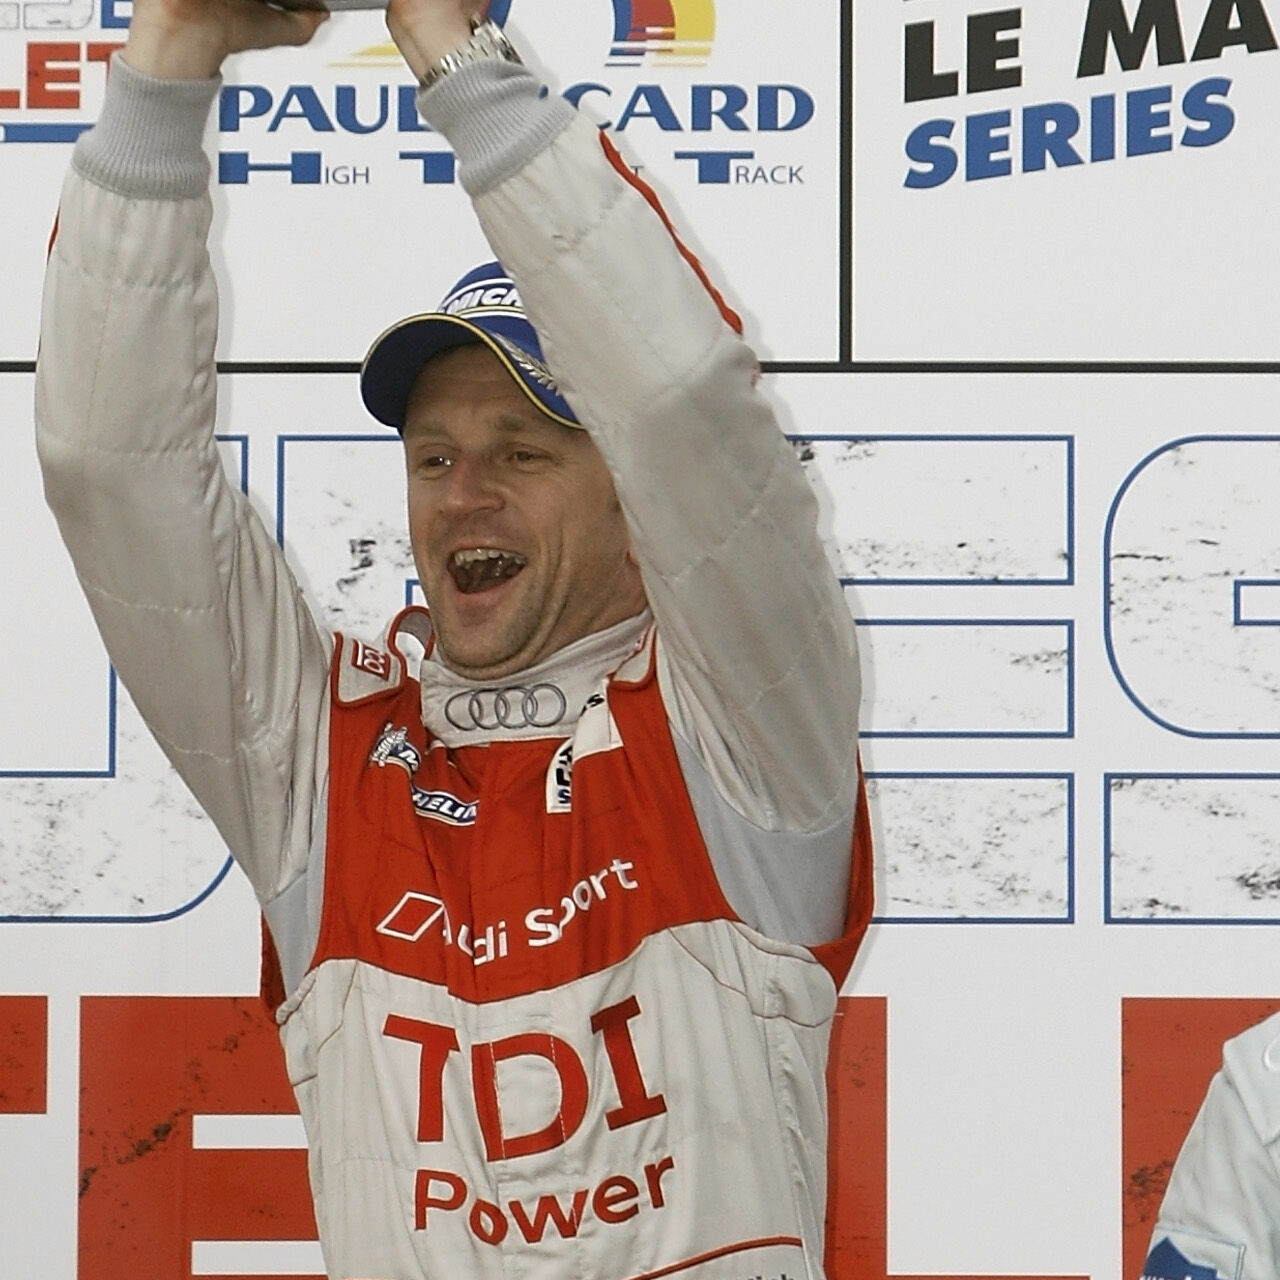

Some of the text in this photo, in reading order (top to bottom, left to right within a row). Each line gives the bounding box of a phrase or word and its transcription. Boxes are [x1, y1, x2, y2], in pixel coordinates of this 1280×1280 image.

[904, 7, 1023, 104] LE
[539, 82, 816, 131] CARD
[903, 76, 1236, 190] SERIES
[382, 995, 668, 1163] TDI
[413, 1156, 675, 1247] Power
